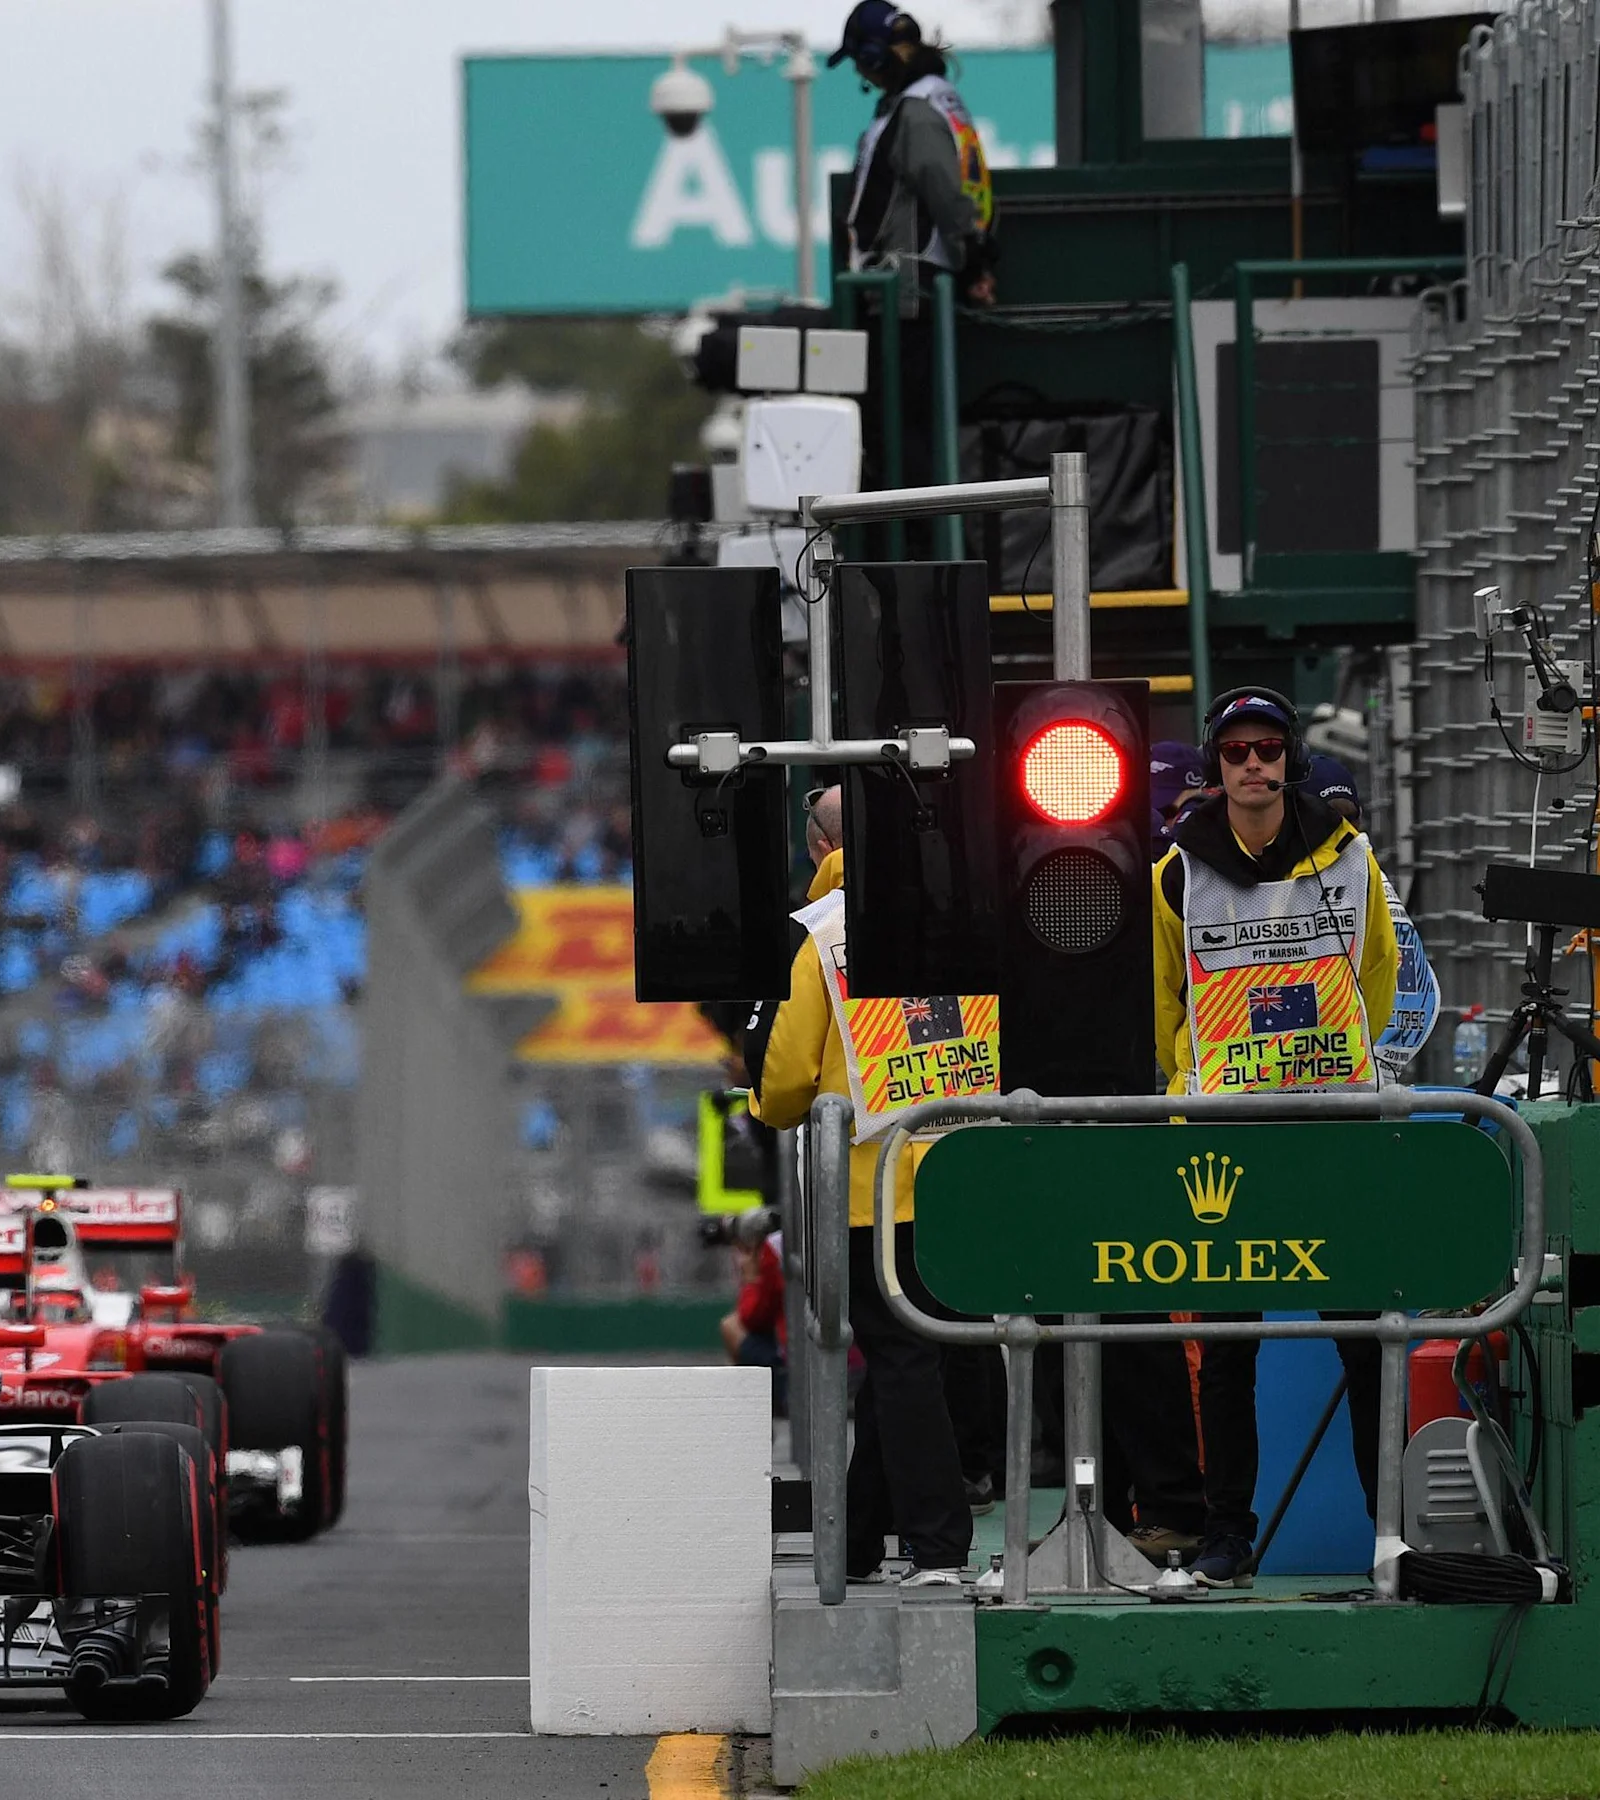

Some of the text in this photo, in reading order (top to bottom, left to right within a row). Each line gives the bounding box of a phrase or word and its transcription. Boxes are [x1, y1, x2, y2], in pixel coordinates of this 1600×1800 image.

[1319, 785, 1354, 798] OFFICIAL
[1317, 914, 1355, 930] 2016
[1252, 945, 1309, 959] PIT MARSHAL
[1228, 1039, 1269, 1064] PIT
[887, 1051, 927, 1078] PIT
[1092, 1239, 1330, 1285] ROLEX
